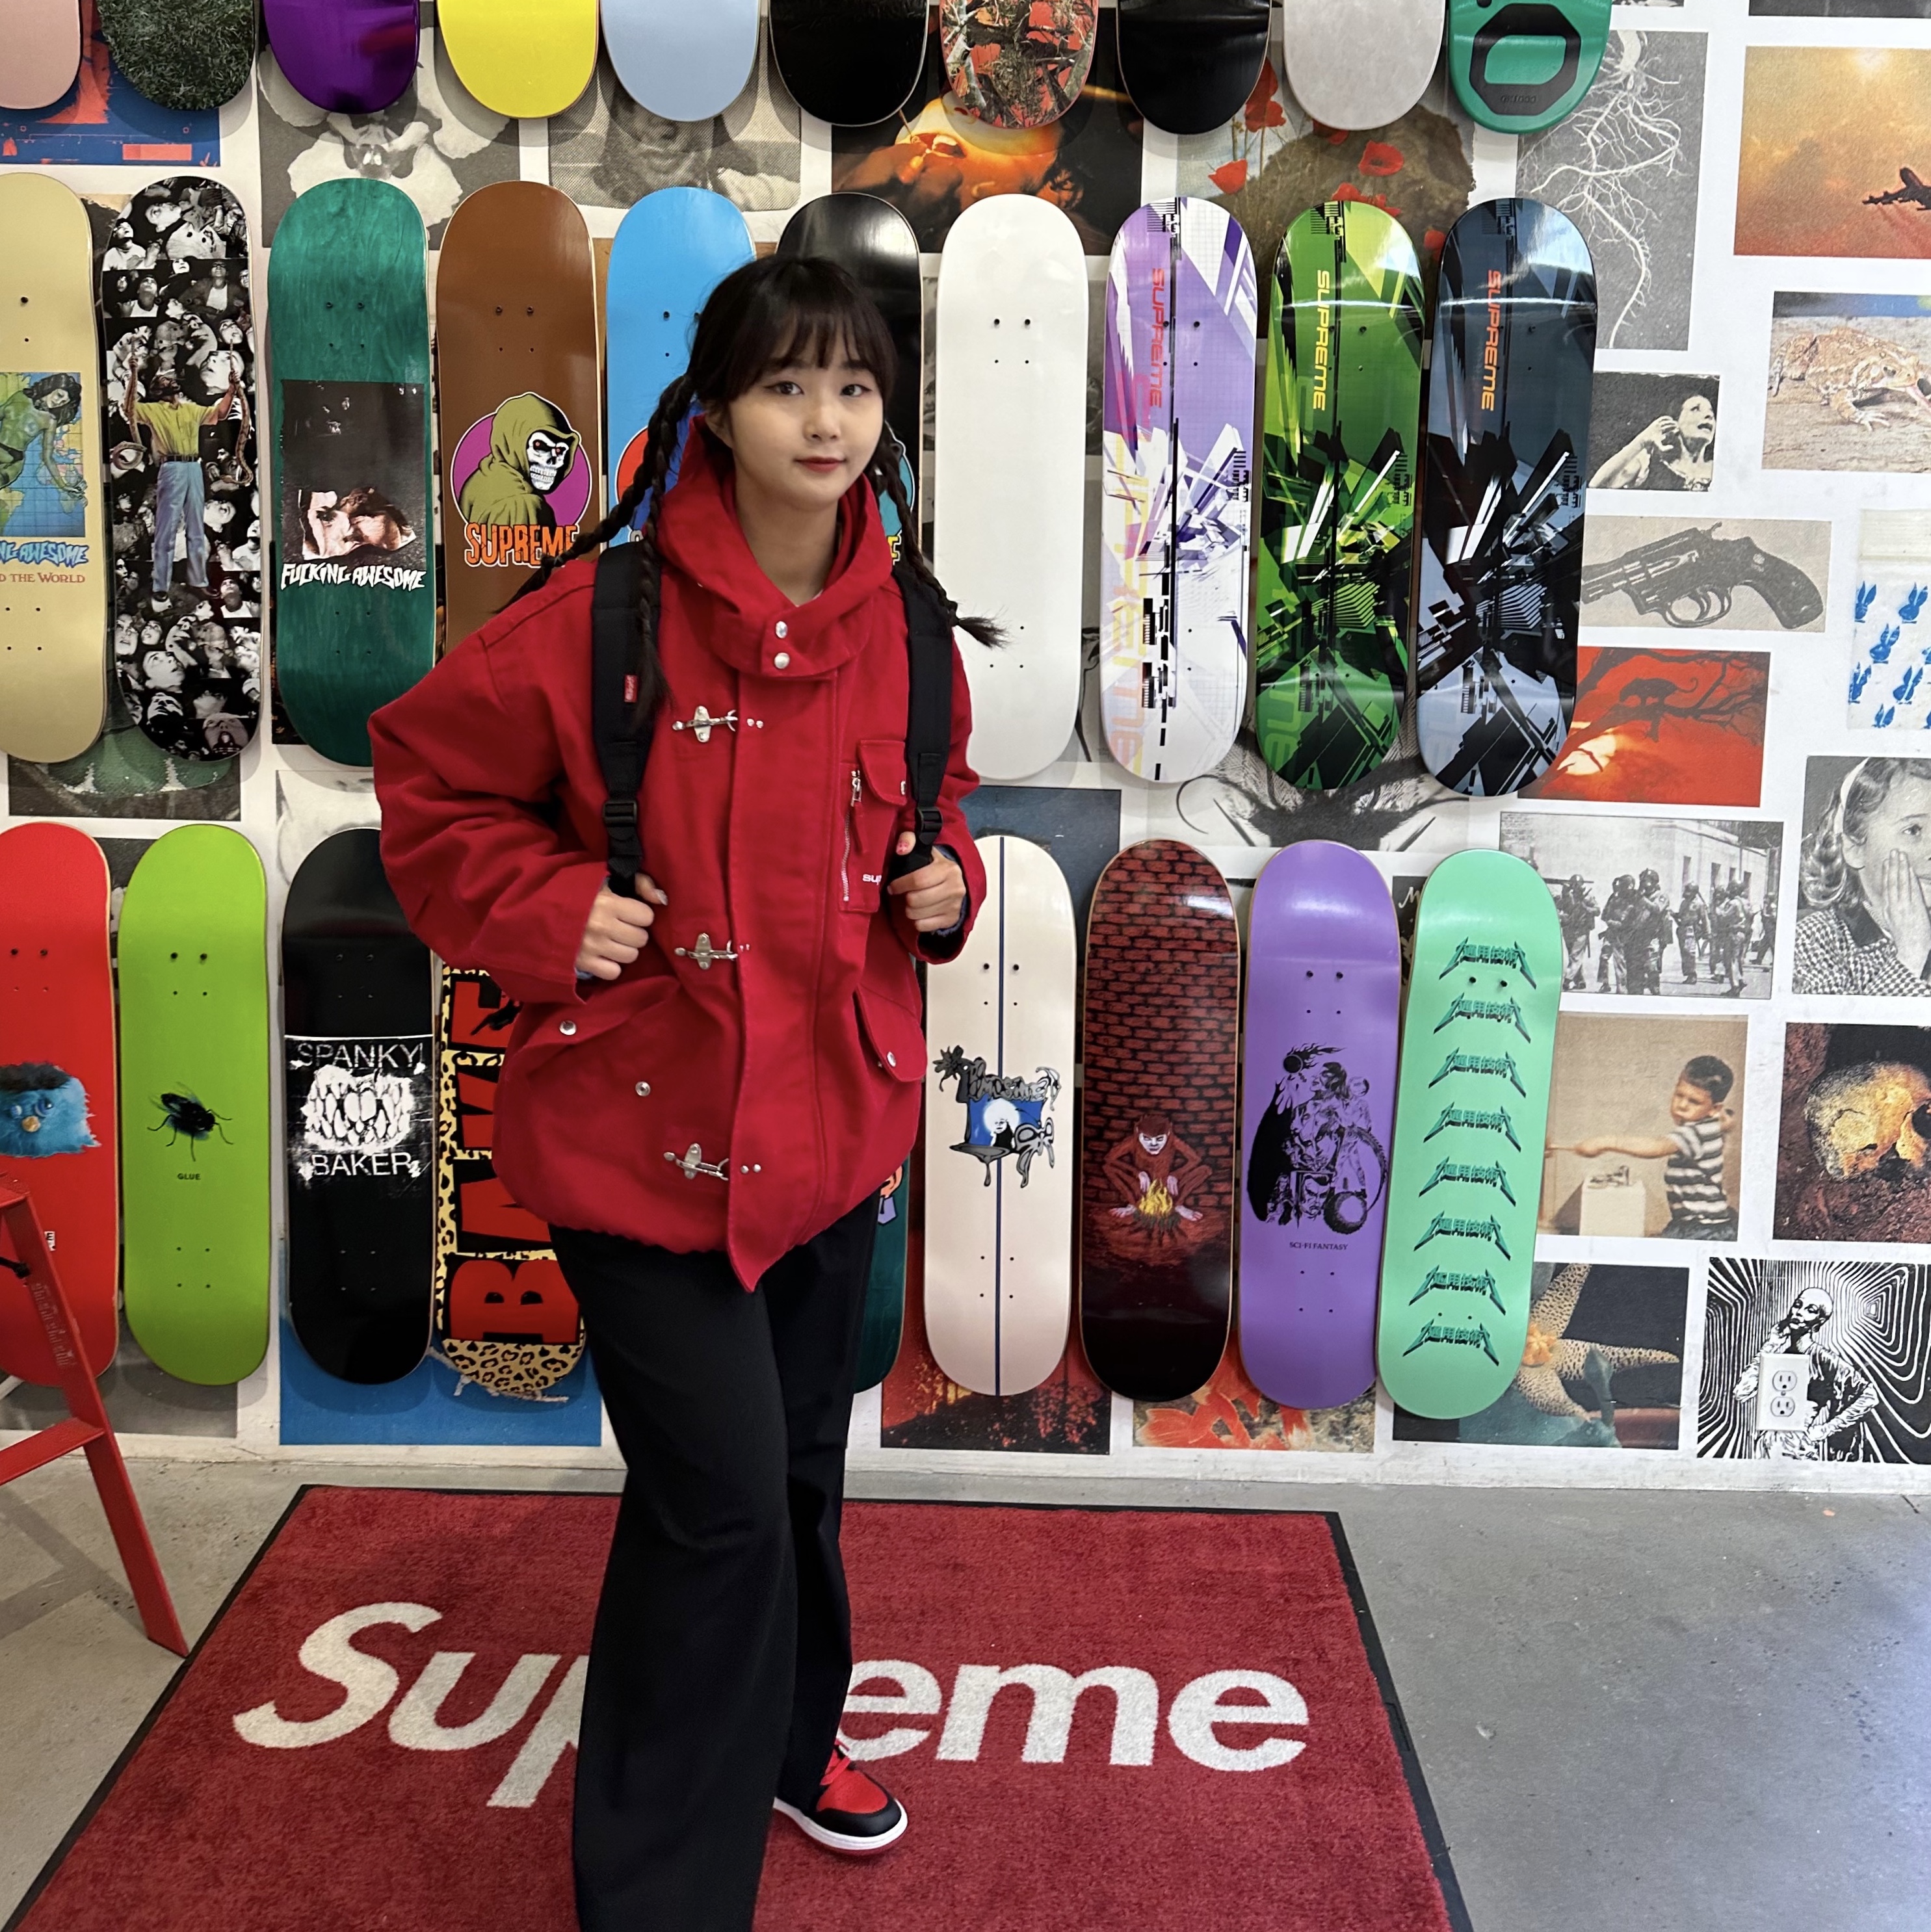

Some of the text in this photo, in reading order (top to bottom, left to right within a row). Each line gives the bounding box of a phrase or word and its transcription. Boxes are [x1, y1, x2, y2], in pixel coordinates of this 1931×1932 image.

[1149, 268, 1164, 408] SUPREME
[1313, 270, 1330, 411] SUPREME
[1482, 270, 1501, 411] SUPREME
[19, 541, 89, 568] AWESOME
[465, 521, 579, 566] SUPREME
[9, 573, 35, 582] THE
[281, 562, 427, 592] FUCKING AWESOME
[177, 1172, 202, 1181] GLUE
[311, 1151, 412, 1177] BAKER
[1313, 1242, 1349, 1251] FANTASY
